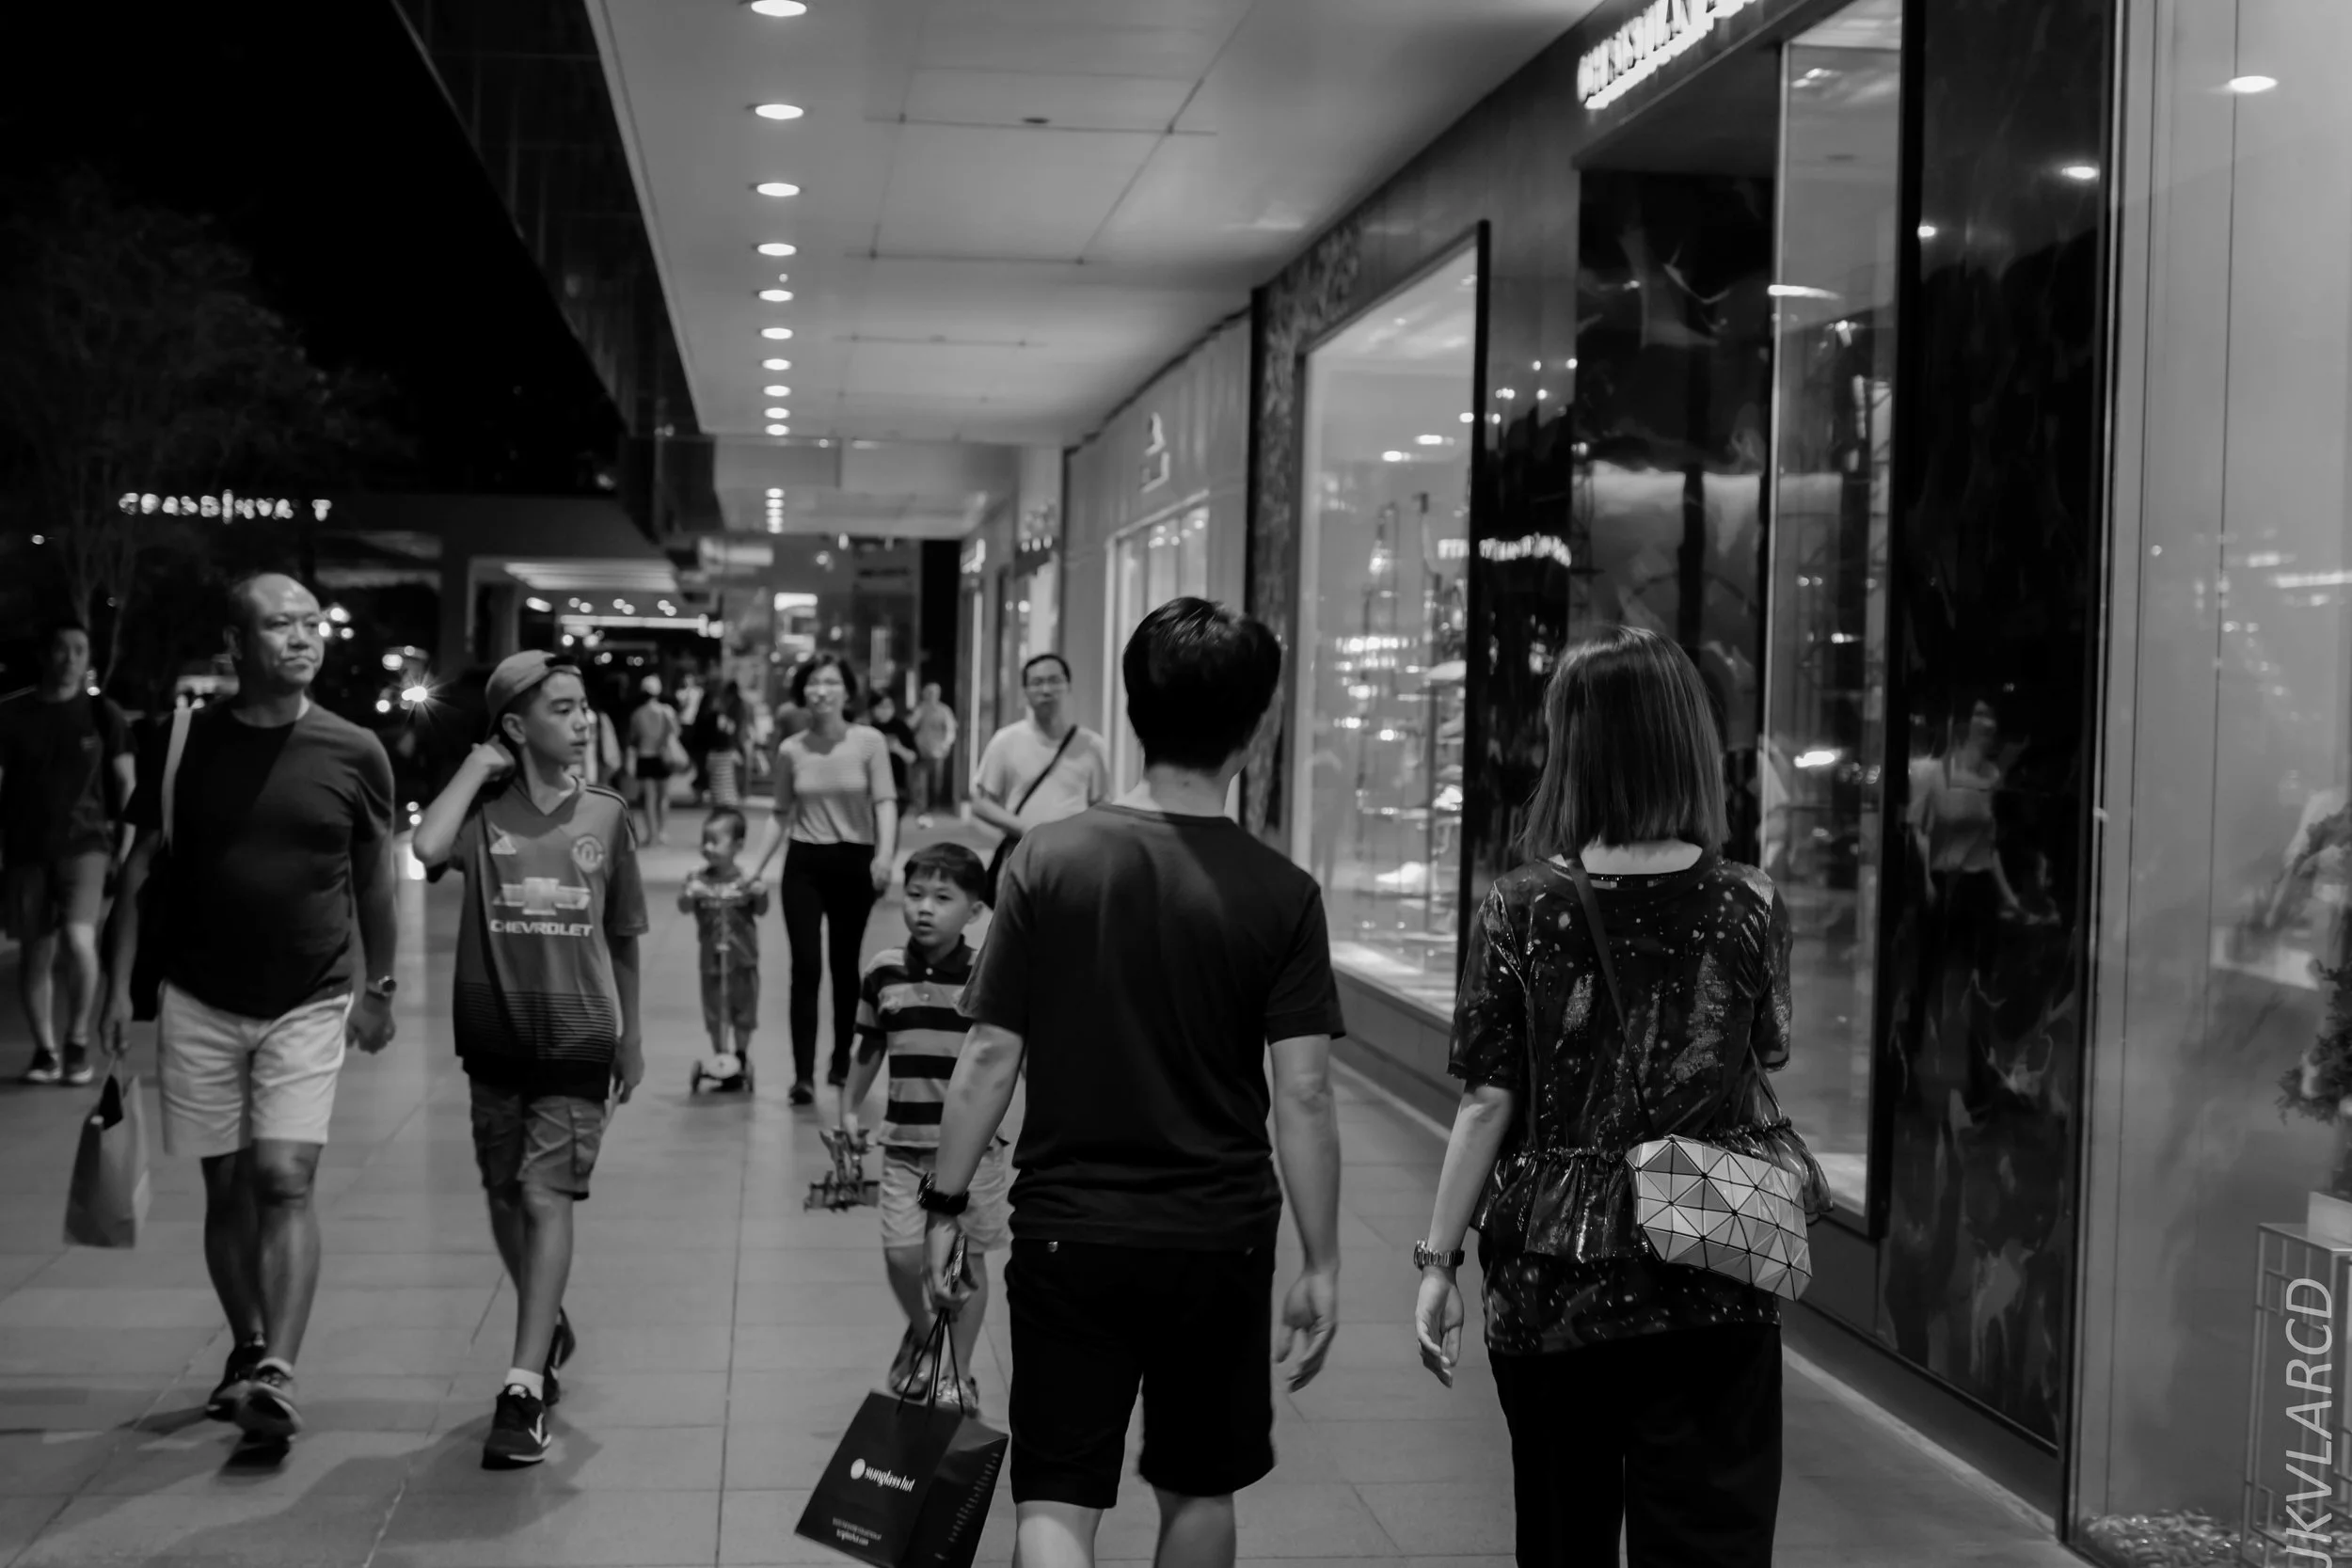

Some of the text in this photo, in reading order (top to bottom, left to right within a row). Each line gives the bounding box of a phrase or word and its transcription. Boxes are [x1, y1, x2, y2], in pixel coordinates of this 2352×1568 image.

[488, 919, 594, 938] CHEVROLET
[865, 1465, 915, 1493] sunglass hut
